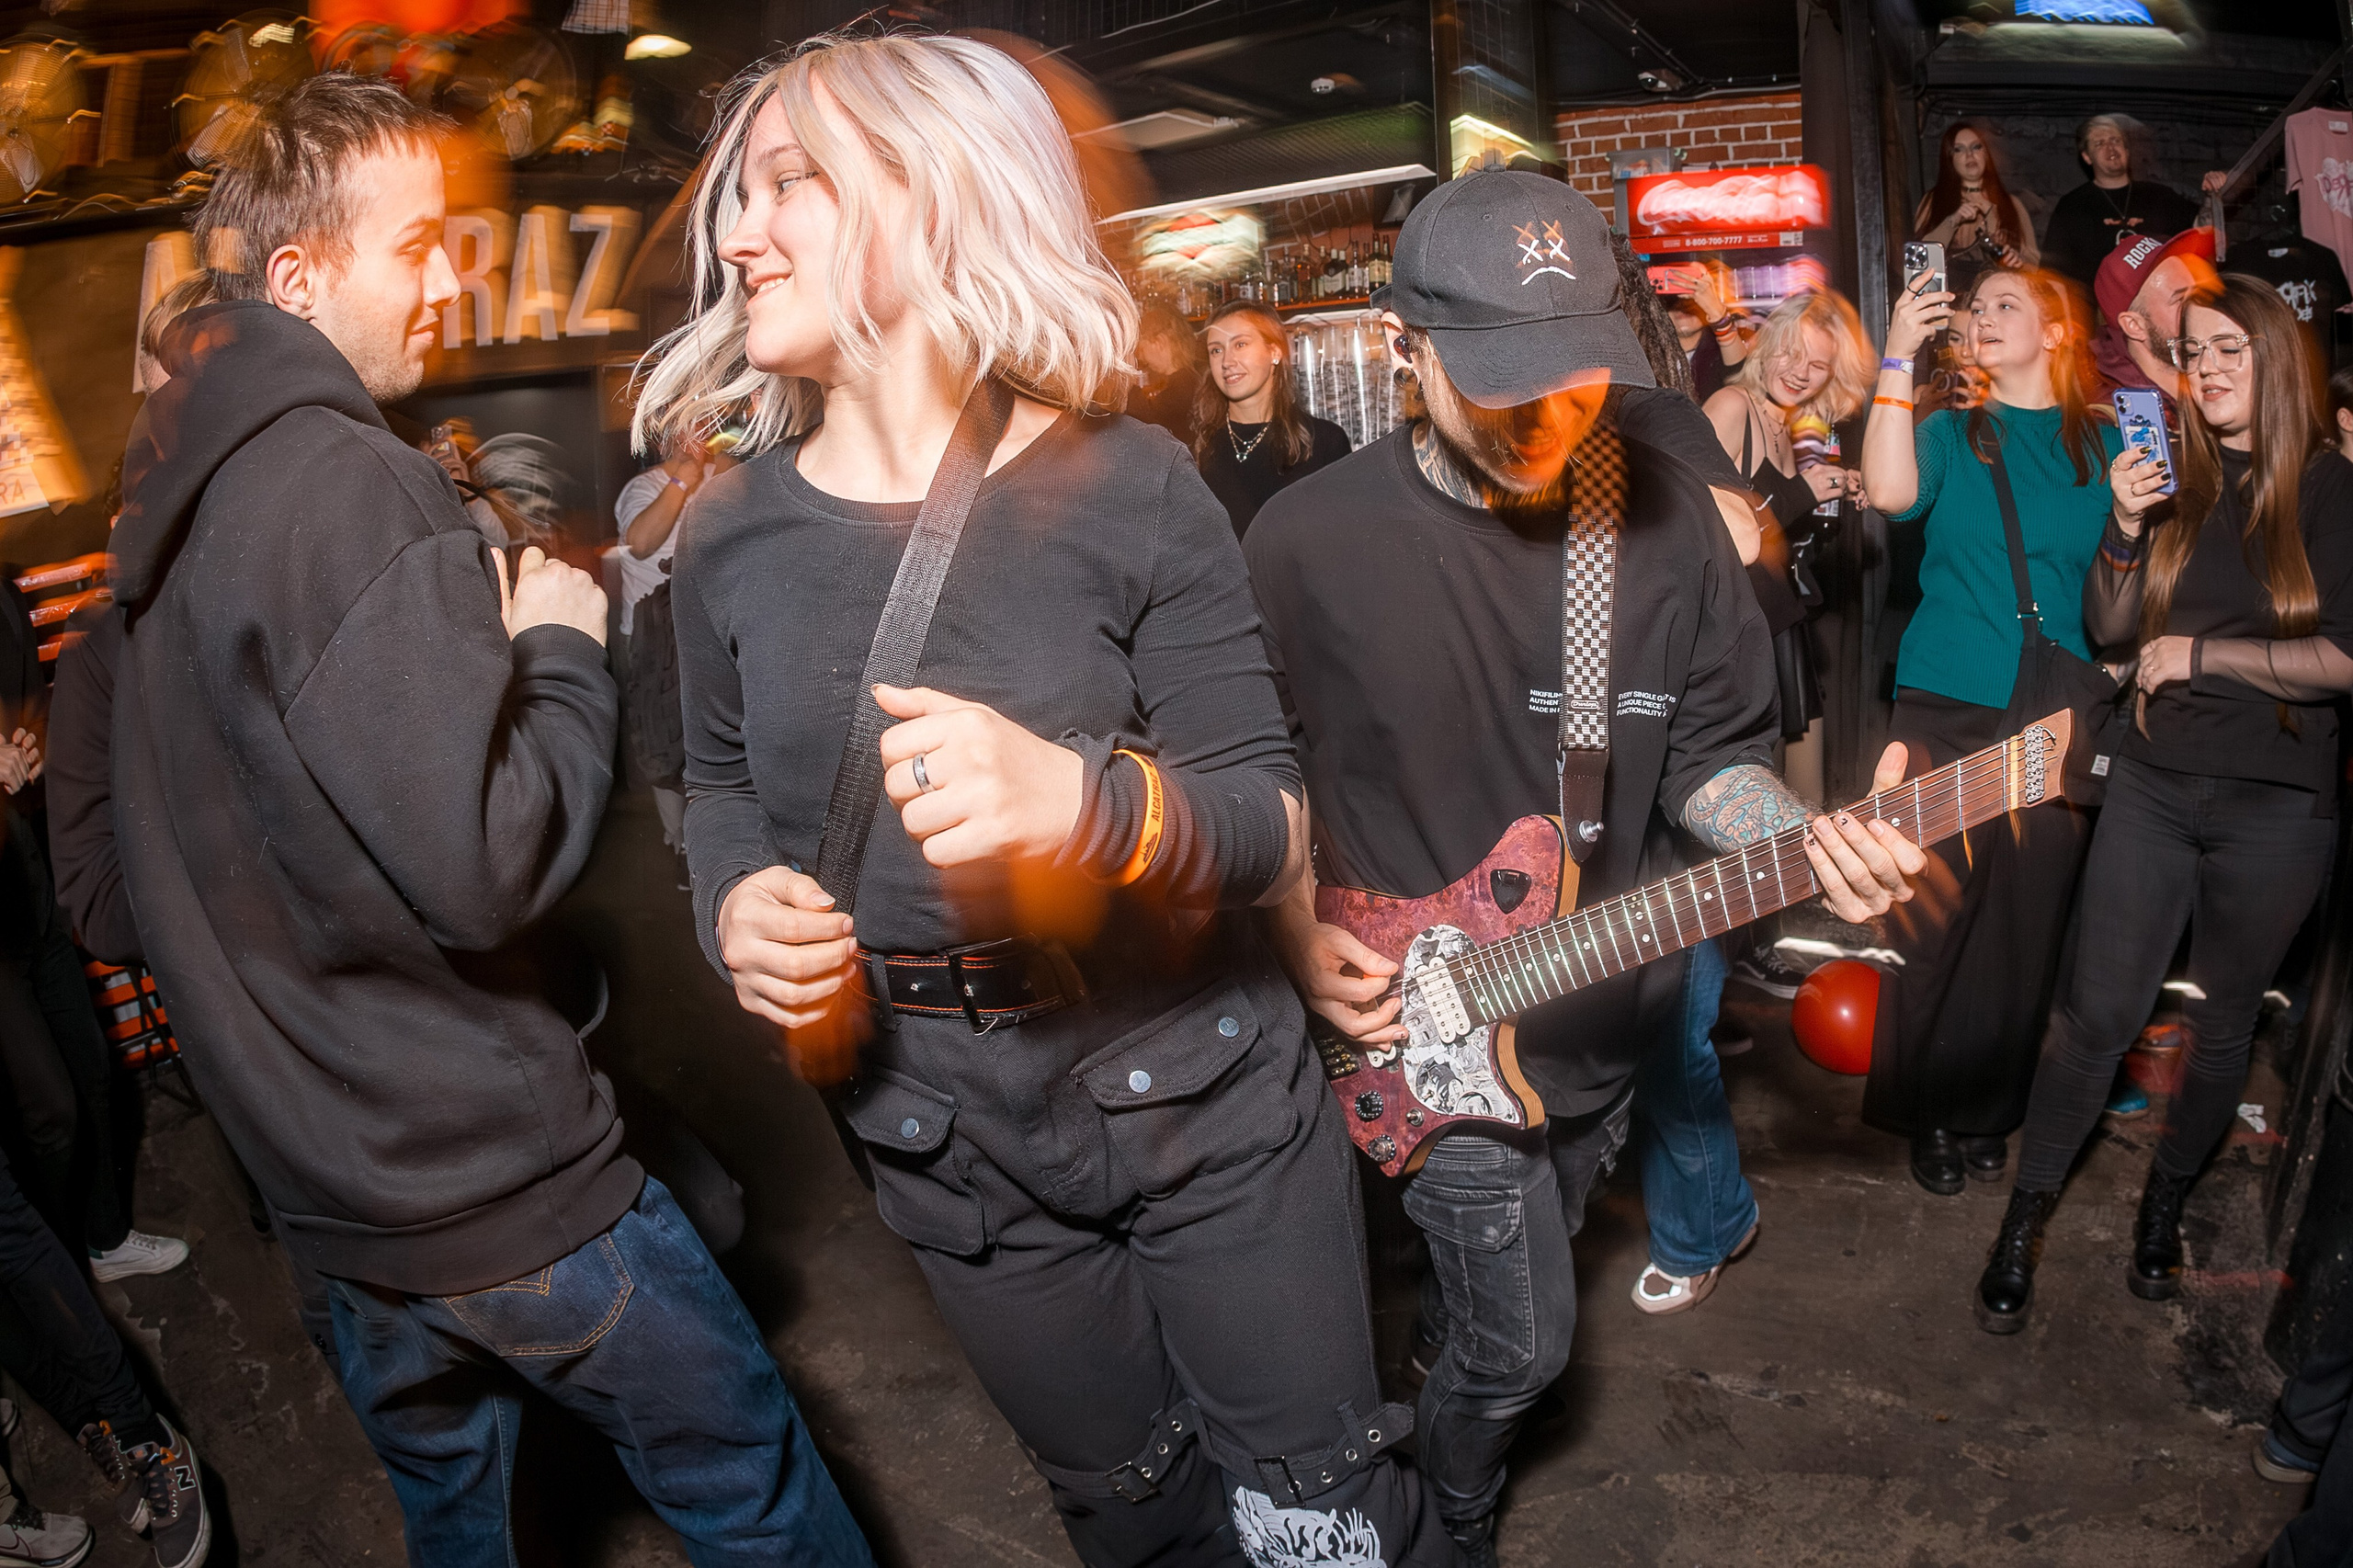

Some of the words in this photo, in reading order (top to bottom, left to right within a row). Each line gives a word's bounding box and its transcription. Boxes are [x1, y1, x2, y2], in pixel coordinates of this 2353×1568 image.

[1685, 235, 1743, 246] 8-800-700-7777
[1633, 690, 1656, 700] SINGLE
[1529, 697, 1560, 706] AUTHEN
[1643, 700, 1662, 710] PIECE
[1529, 704, 1549, 713] MADE
[1616, 707, 1662, 718] FUNCTIONALITY
[1150, 772, 1161, 822] ALCATRAZ
[174, 1465, 196, 1491] N
